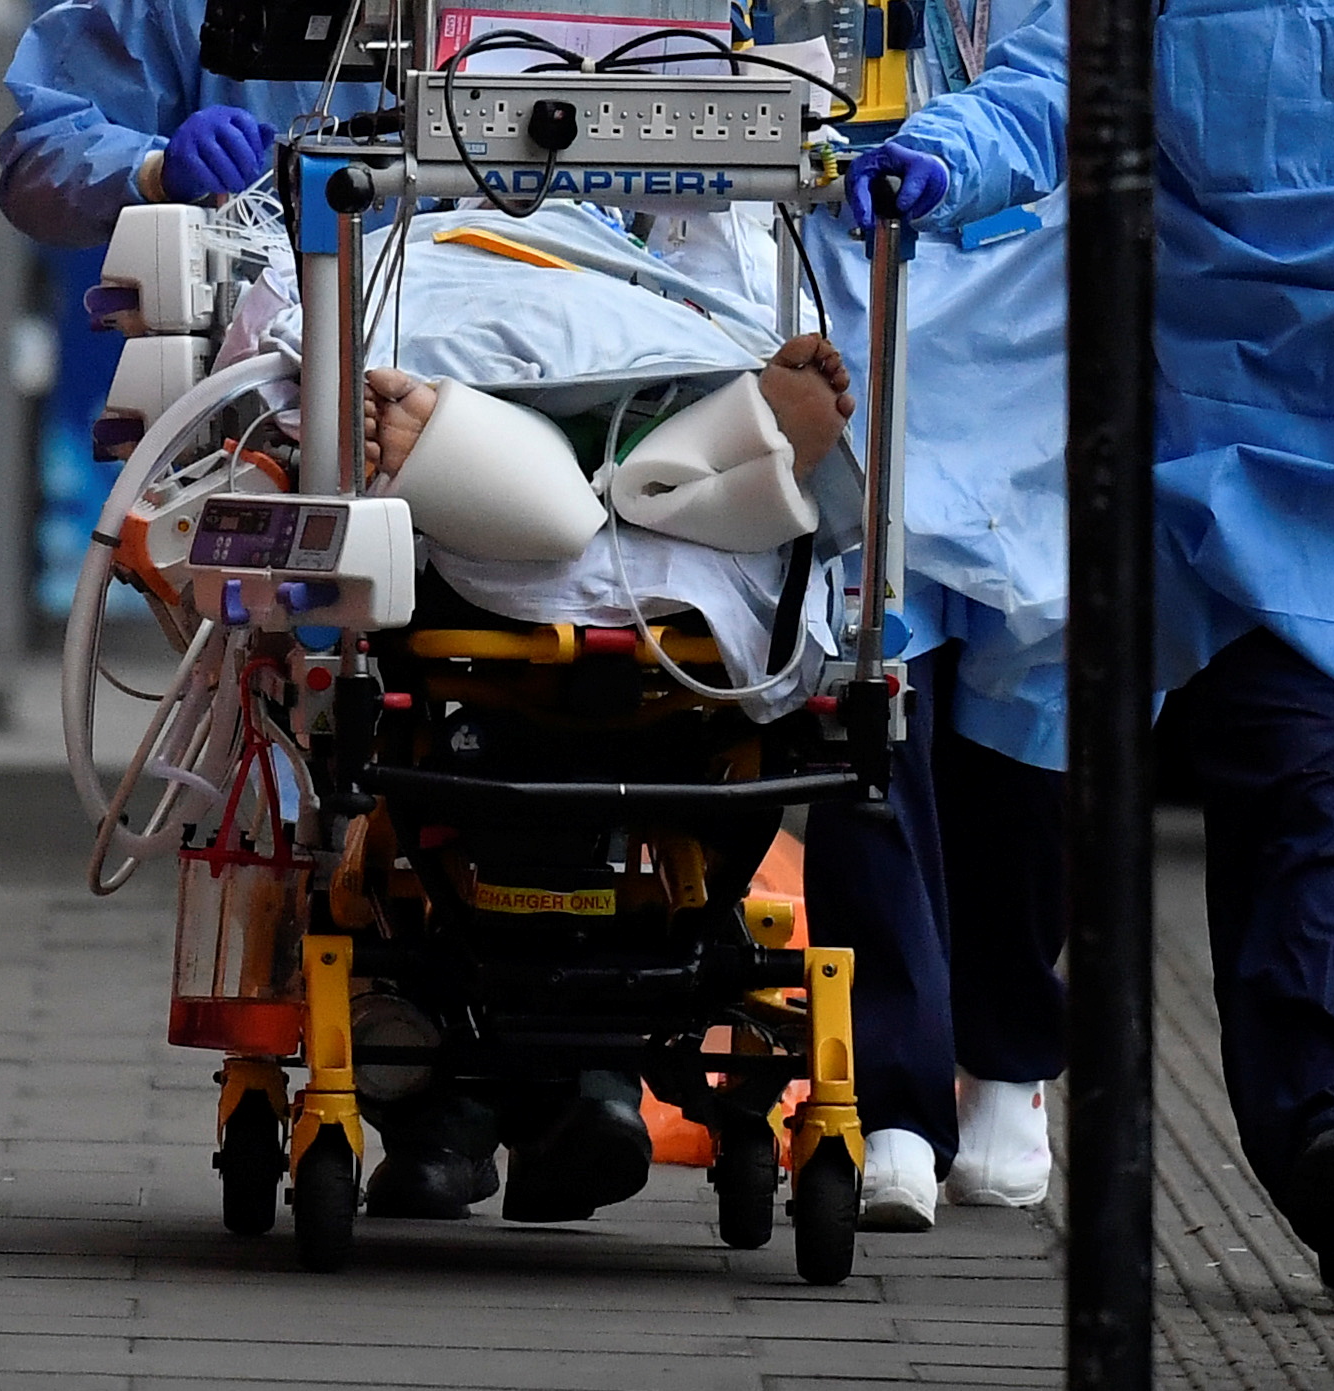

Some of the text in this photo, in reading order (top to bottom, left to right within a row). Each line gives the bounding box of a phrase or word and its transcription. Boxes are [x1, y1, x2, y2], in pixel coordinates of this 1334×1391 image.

[477, 170, 733, 195] ADAPTER+
[478, 889, 612, 910] CHARGER ONLY
